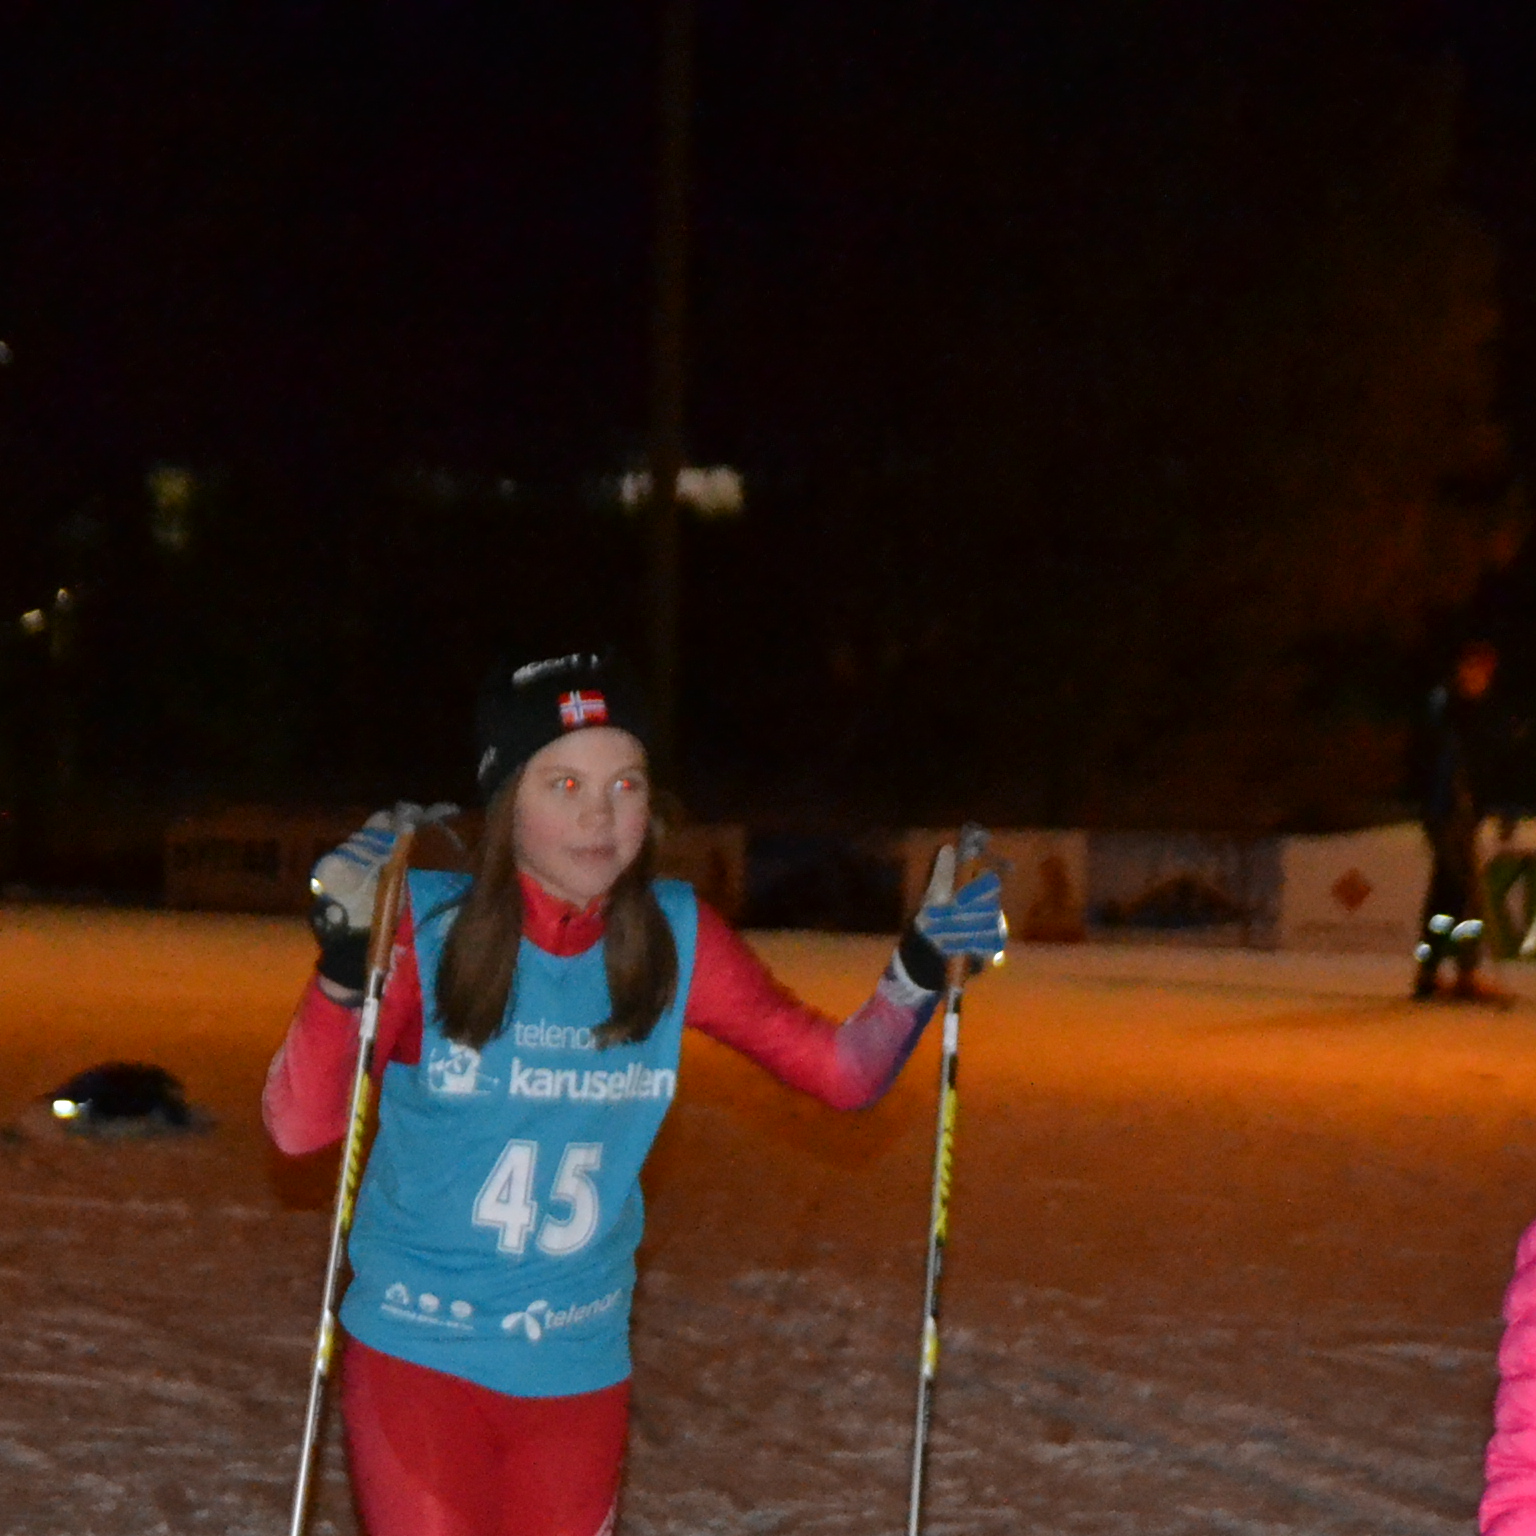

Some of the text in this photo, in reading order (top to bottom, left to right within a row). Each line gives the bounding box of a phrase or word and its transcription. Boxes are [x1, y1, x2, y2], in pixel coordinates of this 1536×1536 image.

[514, 1017, 596, 1050] teleno
[509, 1057, 676, 1100] karusellen
[471, 1138, 603, 1255] 45
[544, 1287, 623, 1329] telenor
